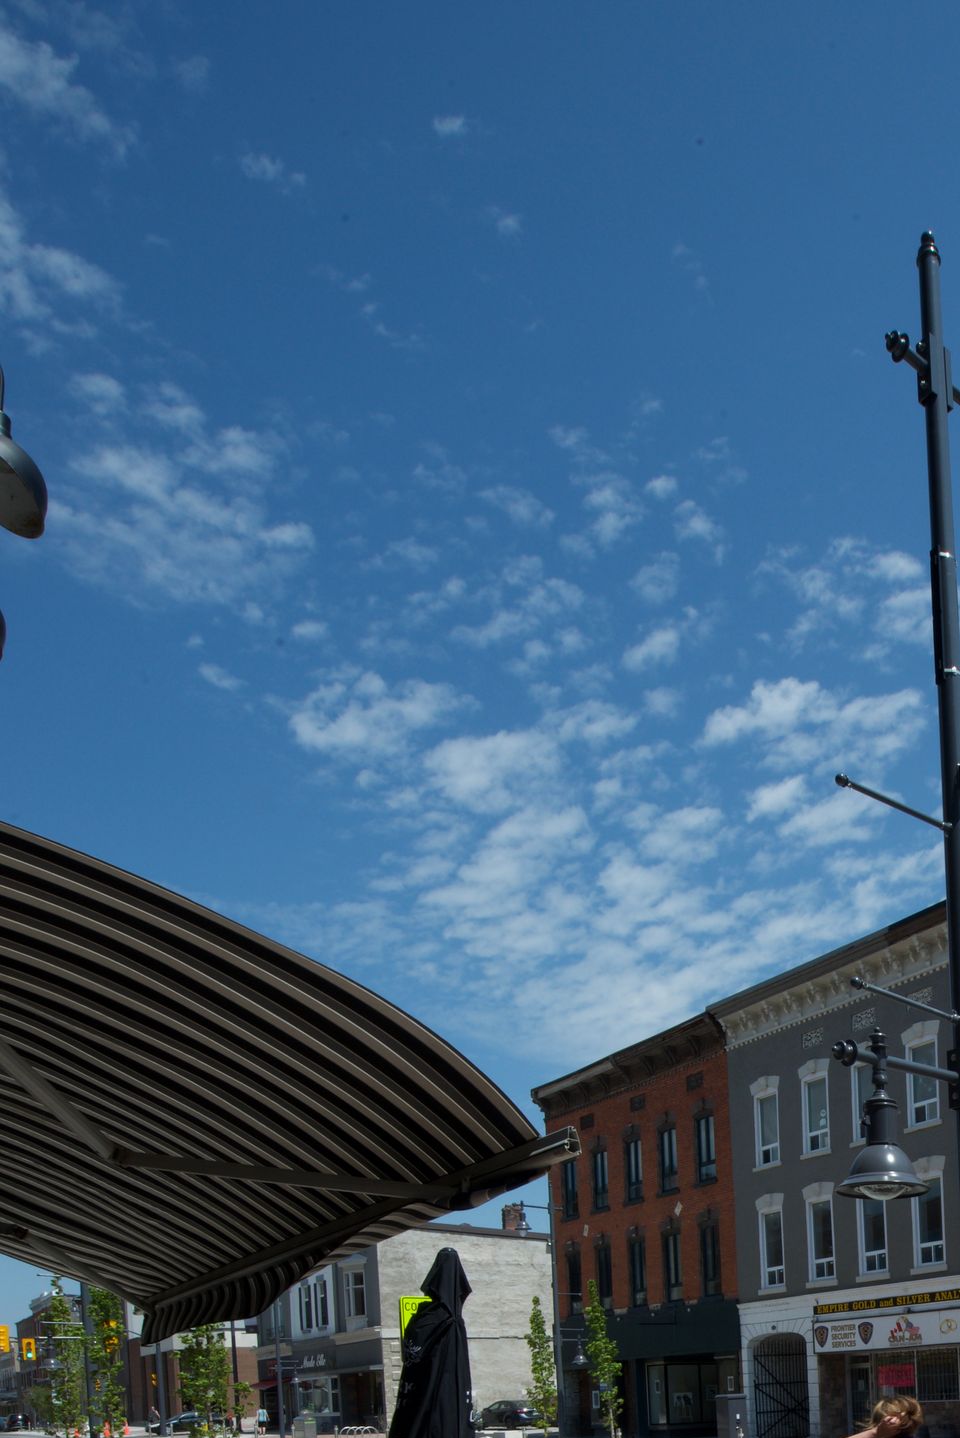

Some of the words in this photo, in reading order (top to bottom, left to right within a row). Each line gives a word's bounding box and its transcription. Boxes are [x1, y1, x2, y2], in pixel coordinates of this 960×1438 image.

[816, 1302, 849, 1314] EMPIRE
[852, 1299, 877, 1310] GOLD
[879, 1298, 894, 1309] and
[897, 1294, 930, 1306] SILVER
[830, 1323, 856, 1333] FRONTIER
[831, 1332, 857, 1341] SECURITY
[831, 1340, 857, 1348] SERVICES
